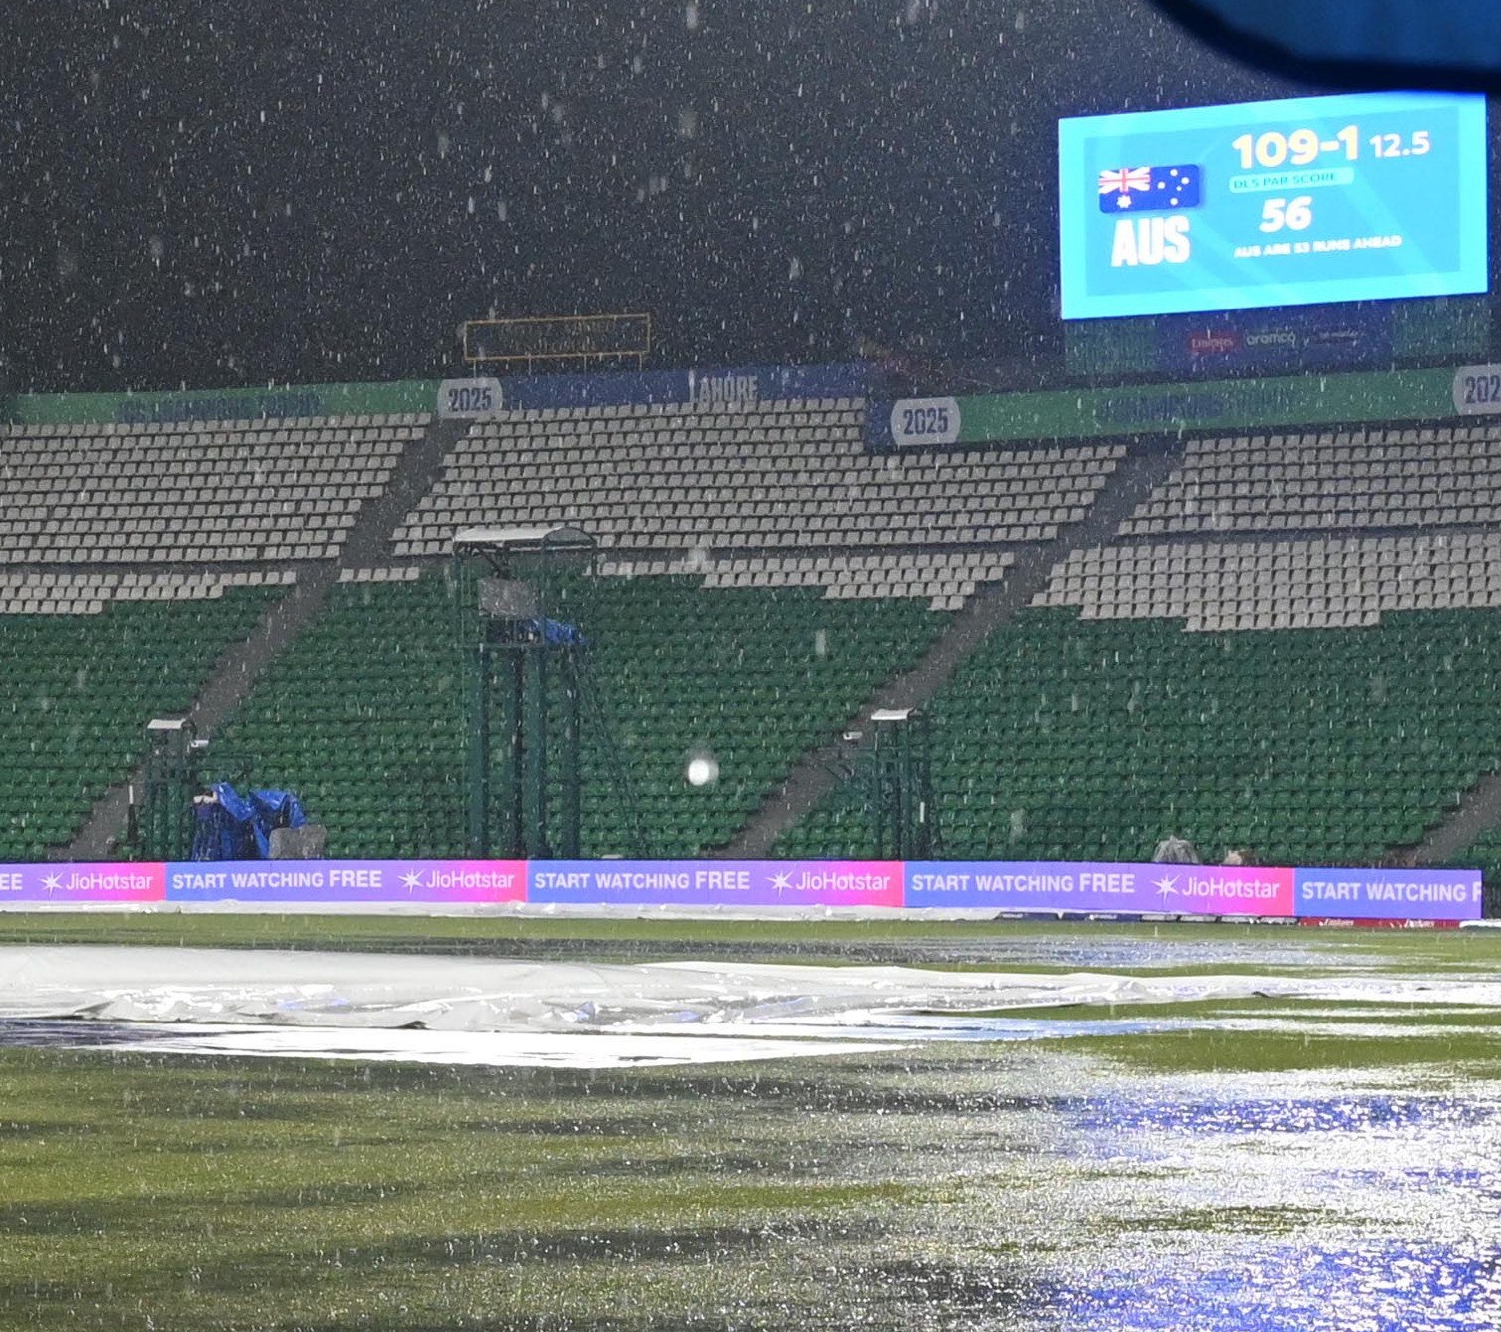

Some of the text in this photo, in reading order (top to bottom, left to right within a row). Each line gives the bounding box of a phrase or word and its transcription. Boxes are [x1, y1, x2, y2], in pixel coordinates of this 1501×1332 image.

[1232, 125, 1430, 169] 109-1 12.5
[1233, 170, 1337, 189] DLS PAR SCORE
[1259, 196, 1313, 234] 56
[1111, 215, 1192, 268] AUS
[1352, 234, 1403, 249] AHEAD
[448, 387, 493, 412] 2025
[689, 373, 758, 404] LAHORE
[903, 409, 948, 436] 2025
[65, 872, 154, 890] JioHotstar
[172, 869, 516, 890] START WATCHING FREE JioHotstar
[534, 870, 891, 891] START WATCHING FREE JioHotstar
[911, 872, 1281, 899] START WATCHING FREE JioHotstar
[1302, 881, 1362, 901] START
[1365, 882, 1467, 902] WATCHING
